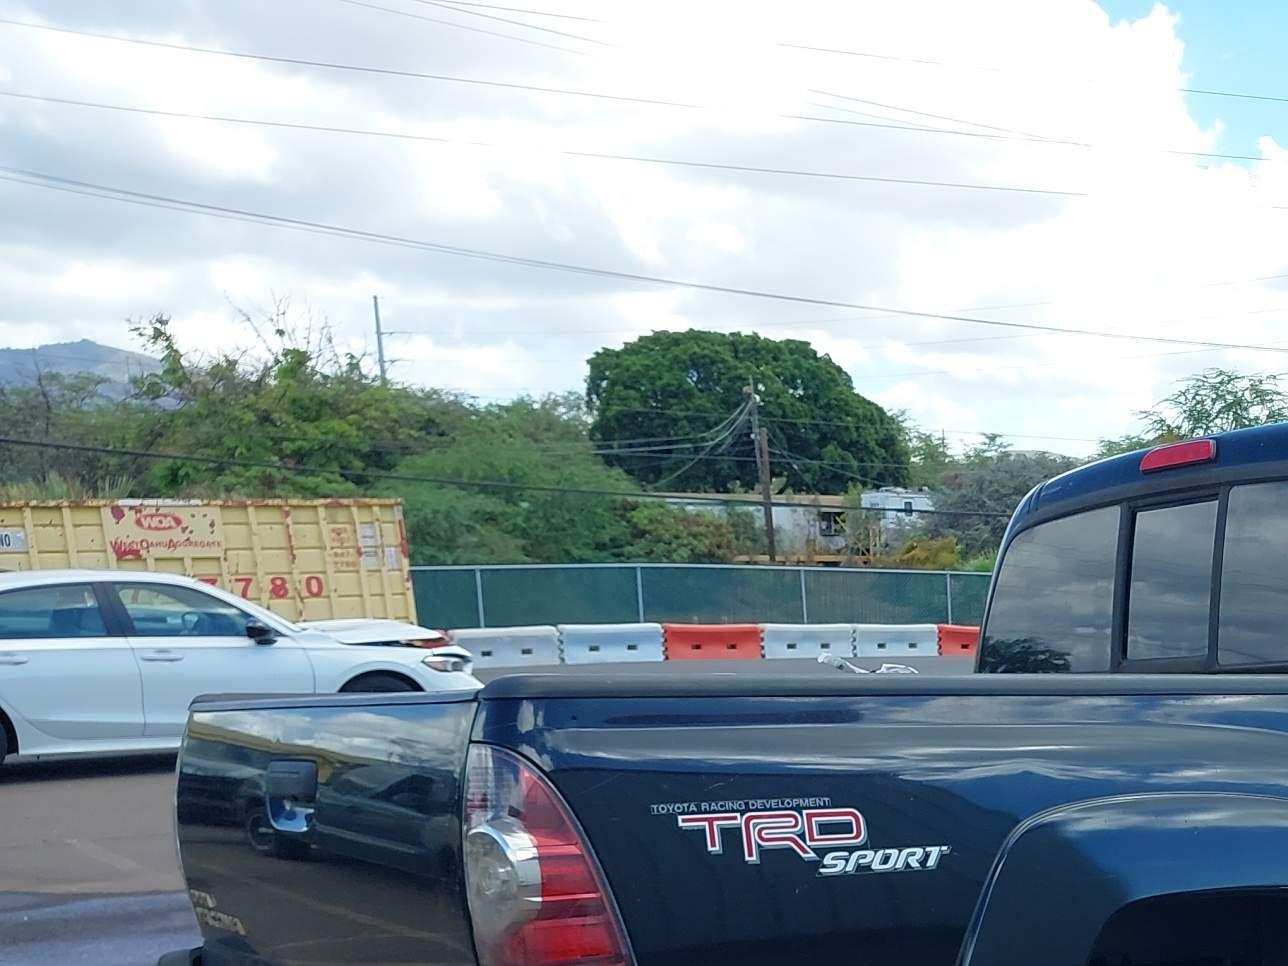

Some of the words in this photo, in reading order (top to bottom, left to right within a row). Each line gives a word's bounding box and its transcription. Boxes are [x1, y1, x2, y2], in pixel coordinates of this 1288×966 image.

[141, 515, 179, 528] WOA
[651, 802, 698, 814] TOYOTA
[701, 800, 745, 812] RACING
[748, 797, 832, 810] DEVELOPMENT
[678, 807, 870, 864] TRD
[817, 845, 951, 876] SPORT
